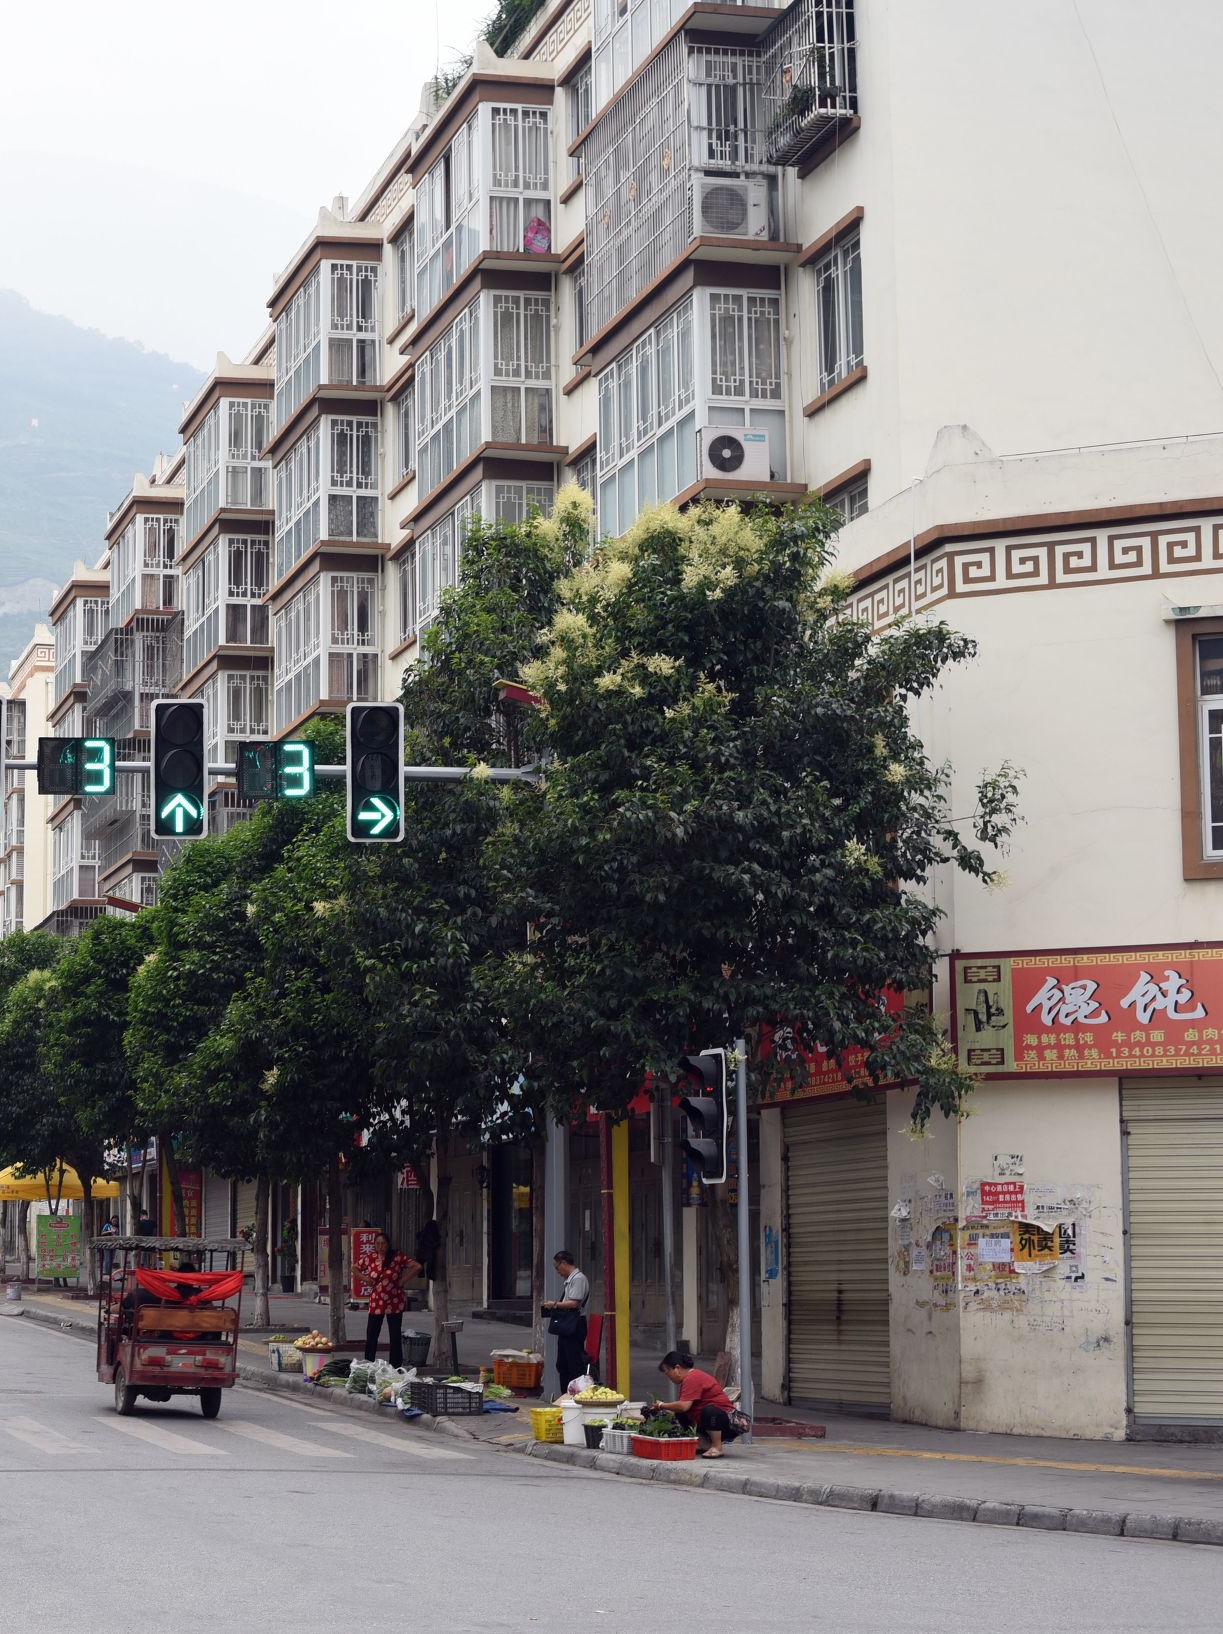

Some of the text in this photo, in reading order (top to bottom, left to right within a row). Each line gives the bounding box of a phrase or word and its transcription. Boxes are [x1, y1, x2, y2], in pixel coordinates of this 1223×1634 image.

[84, 740, 111, 792] 3
[283, 744, 310, 796] 3
[1025, 969, 1208, 1027] 馄饨
[1022, 1027, 1223, 1047] 海鲜馄饨 牛肉面 卤肉
[1019, 1236, 1055, 1258] 外卖
[1058, 1239, 1076, 1256] 卖
